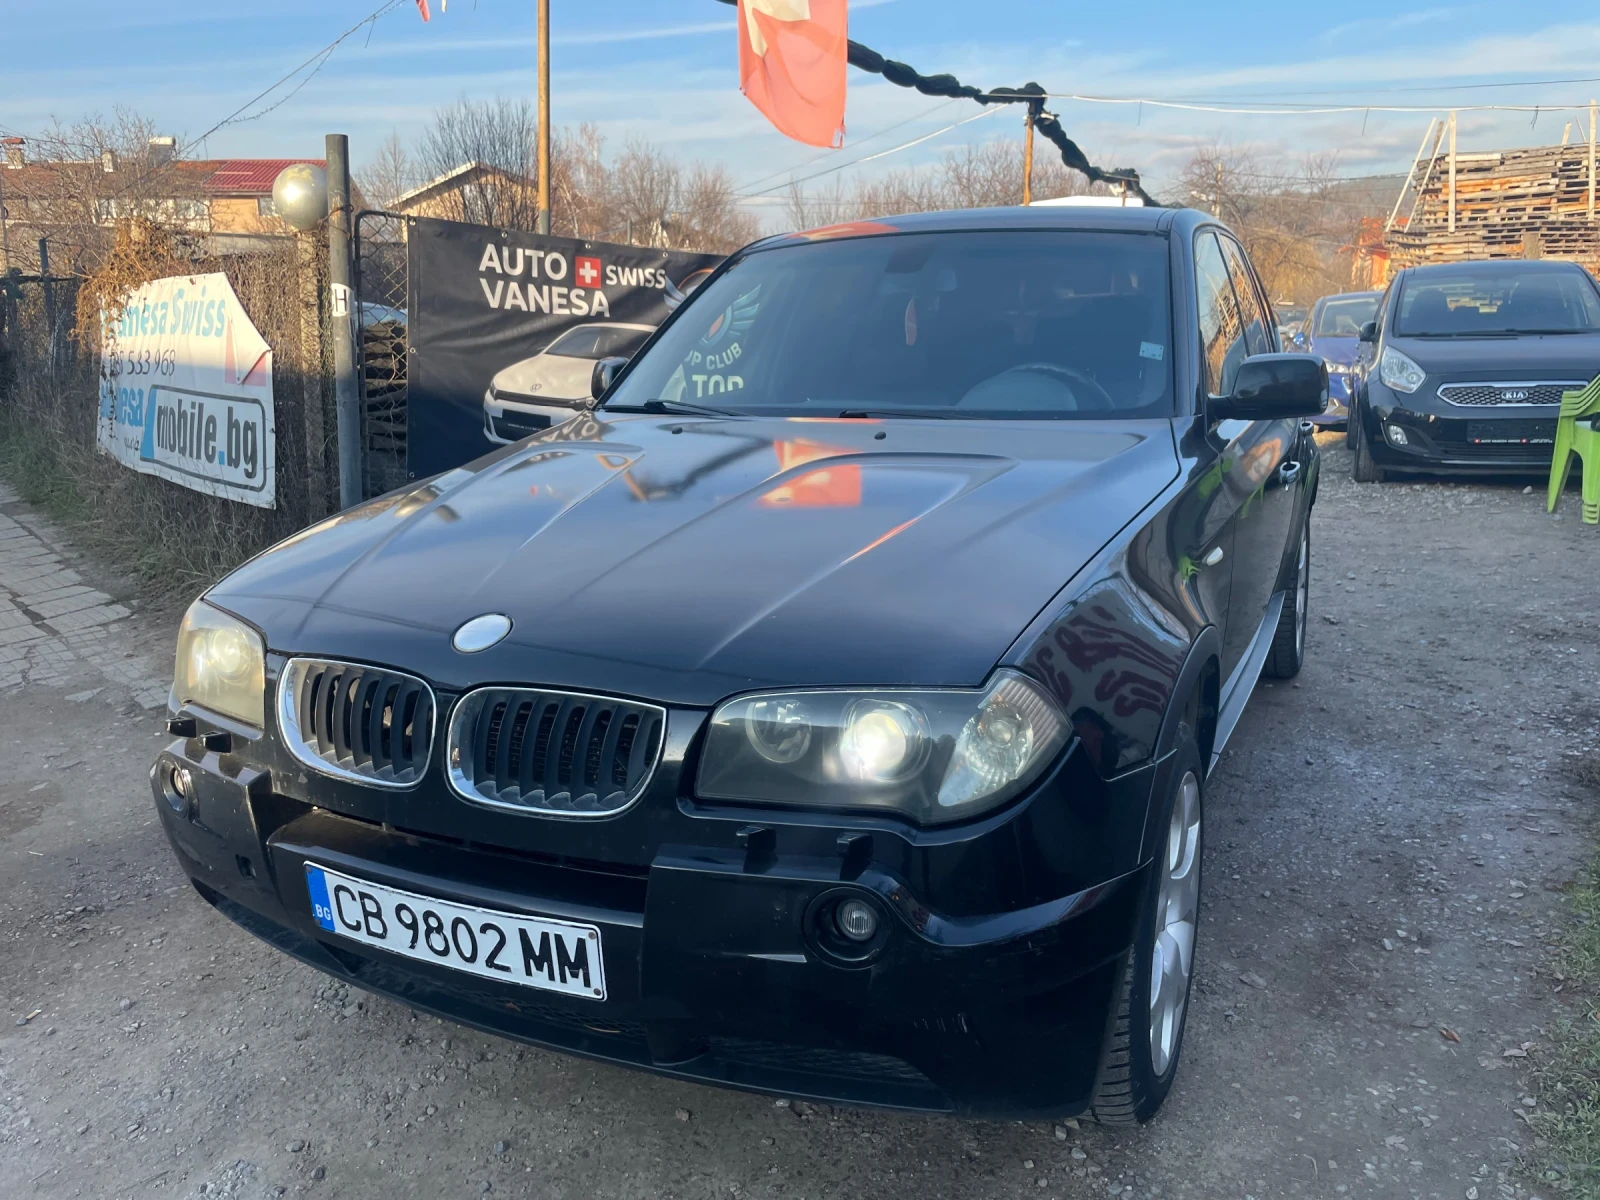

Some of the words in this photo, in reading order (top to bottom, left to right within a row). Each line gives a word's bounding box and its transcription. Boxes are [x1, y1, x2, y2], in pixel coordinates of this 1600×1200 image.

[479, 243, 567, 281] AUTO
[605, 264, 666, 289] SWISS
[101, 302, 169, 337] anesa
[170, 288, 226, 338] Swiss
[334, 288, 347, 312] H
[479, 278, 610, 318] VANESA
[706, 342, 742, 370] CLUB
[1505, 391, 1524, 399] KIA
[156, 398, 258, 480] mobile.bg
[315, 903, 331, 921] BG
[333, 884, 388, 939] CB
[395, 903, 512, 973] 9802
[518, 927, 591, 988] MM
